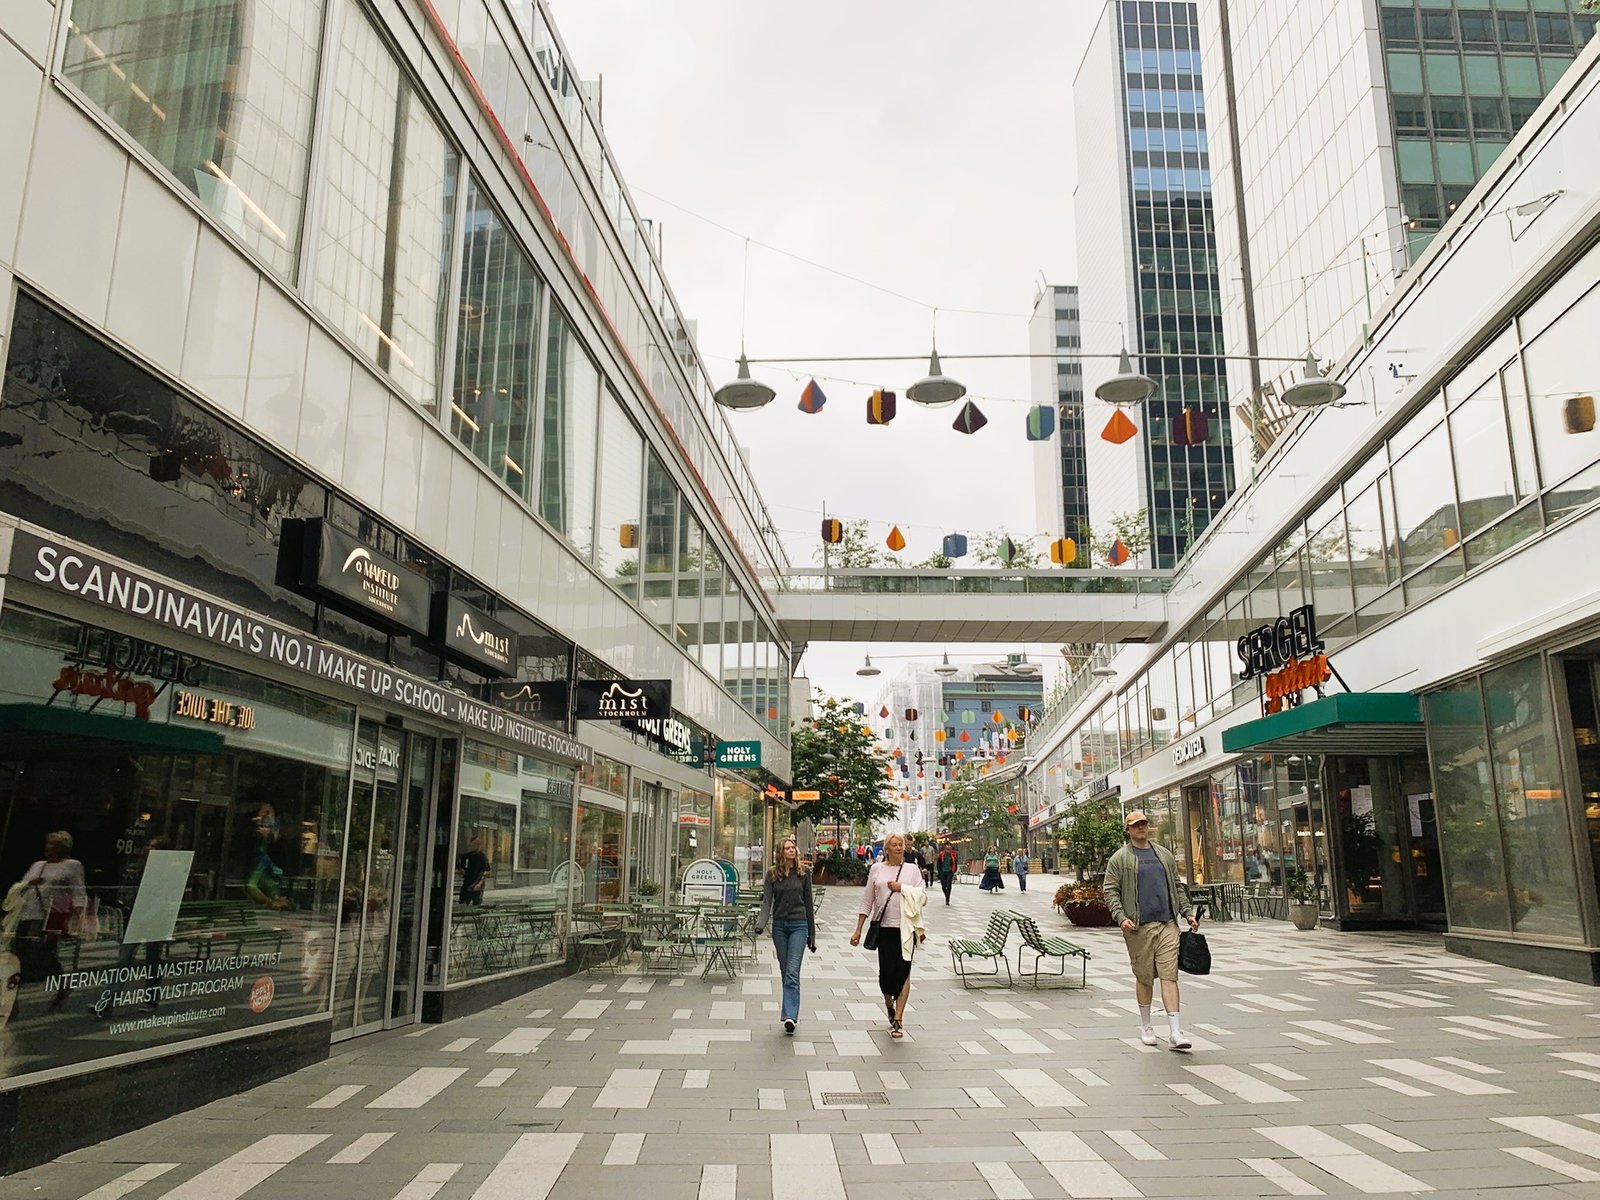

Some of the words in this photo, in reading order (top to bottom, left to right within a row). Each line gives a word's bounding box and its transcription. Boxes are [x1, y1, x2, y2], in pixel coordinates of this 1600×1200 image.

[363, 560, 400, 591] MAKEUP
[362, 579, 398, 606] INSTITUTE
[34, 546, 265, 654] SCANDINAVIA'S
[269, 633, 313, 672] NO.1
[317, 653, 366, 694] MAKE
[370, 673, 393, 703] UP
[394, 678, 448, 717] SCHOOL
[457, 700, 488, 729] MAKE
[490, 711, 504, 733] UP
[505, 718, 546, 749] INSTITUTE
[547, 733, 589, 762] STOCKHOLM
[1237, 604, 1325, 680] SERGEL
[598, 695, 648, 710] mist
[663, 718, 692, 751] GREENS
[720, 754, 757, 762] GREENS
[727, 746, 752, 755] HOLY
[44, 964, 154, 993] INTERNATIONAL
[157, 960, 204, 980] MASTER
[205, 955, 250, 974] MAKEUP
[250, 952, 282, 968] ARTIST
[112, 982, 190, 1008] HAIRSTYLIST
[190, 976, 244, 996] PROGRAM
[250, 983, 272, 1000] APPLY
[109, 1004, 226, 1036] www.makeupinstitute.com
